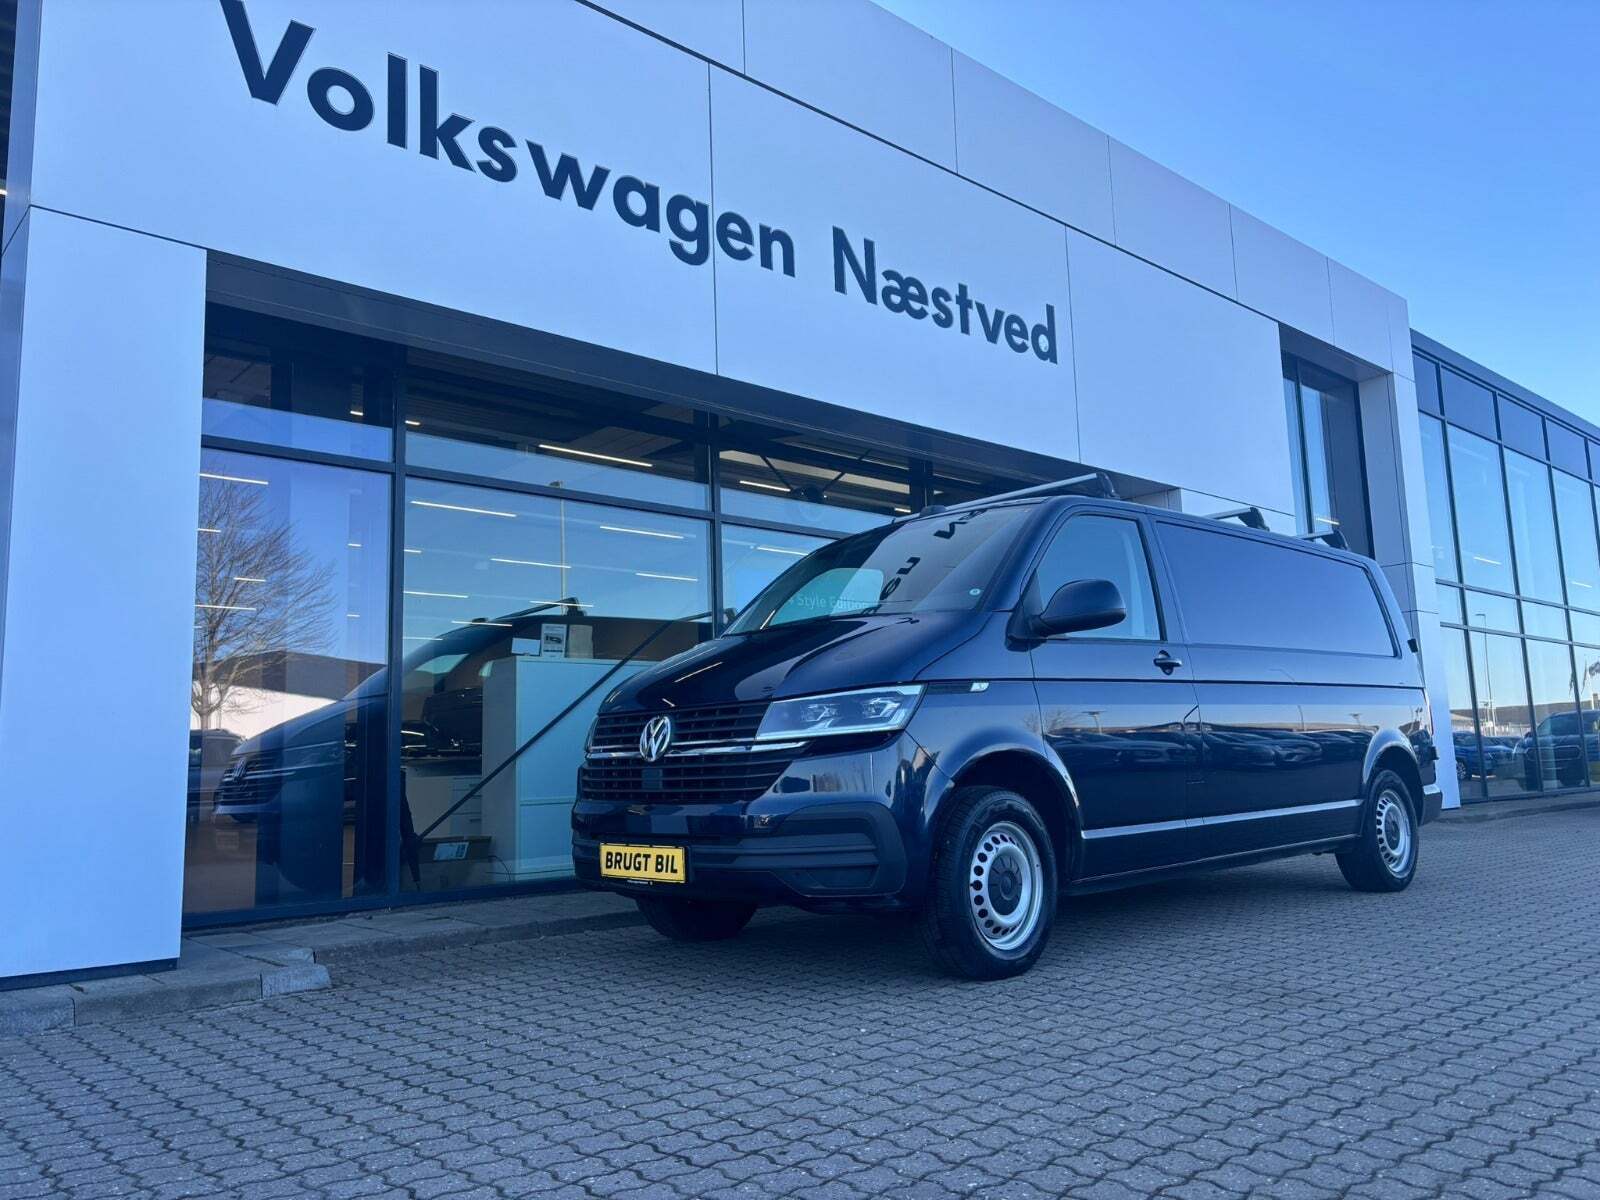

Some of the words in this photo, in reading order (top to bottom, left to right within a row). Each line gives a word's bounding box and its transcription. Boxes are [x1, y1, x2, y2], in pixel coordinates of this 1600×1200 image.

[220, 0, 796, 278] Volkswagen
[832, 226, 1058, 364] Næstved
[797, 592, 826, 609] Style
[605, 851, 651, 871] BRUGT
[655, 854, 678, 874] BIL
